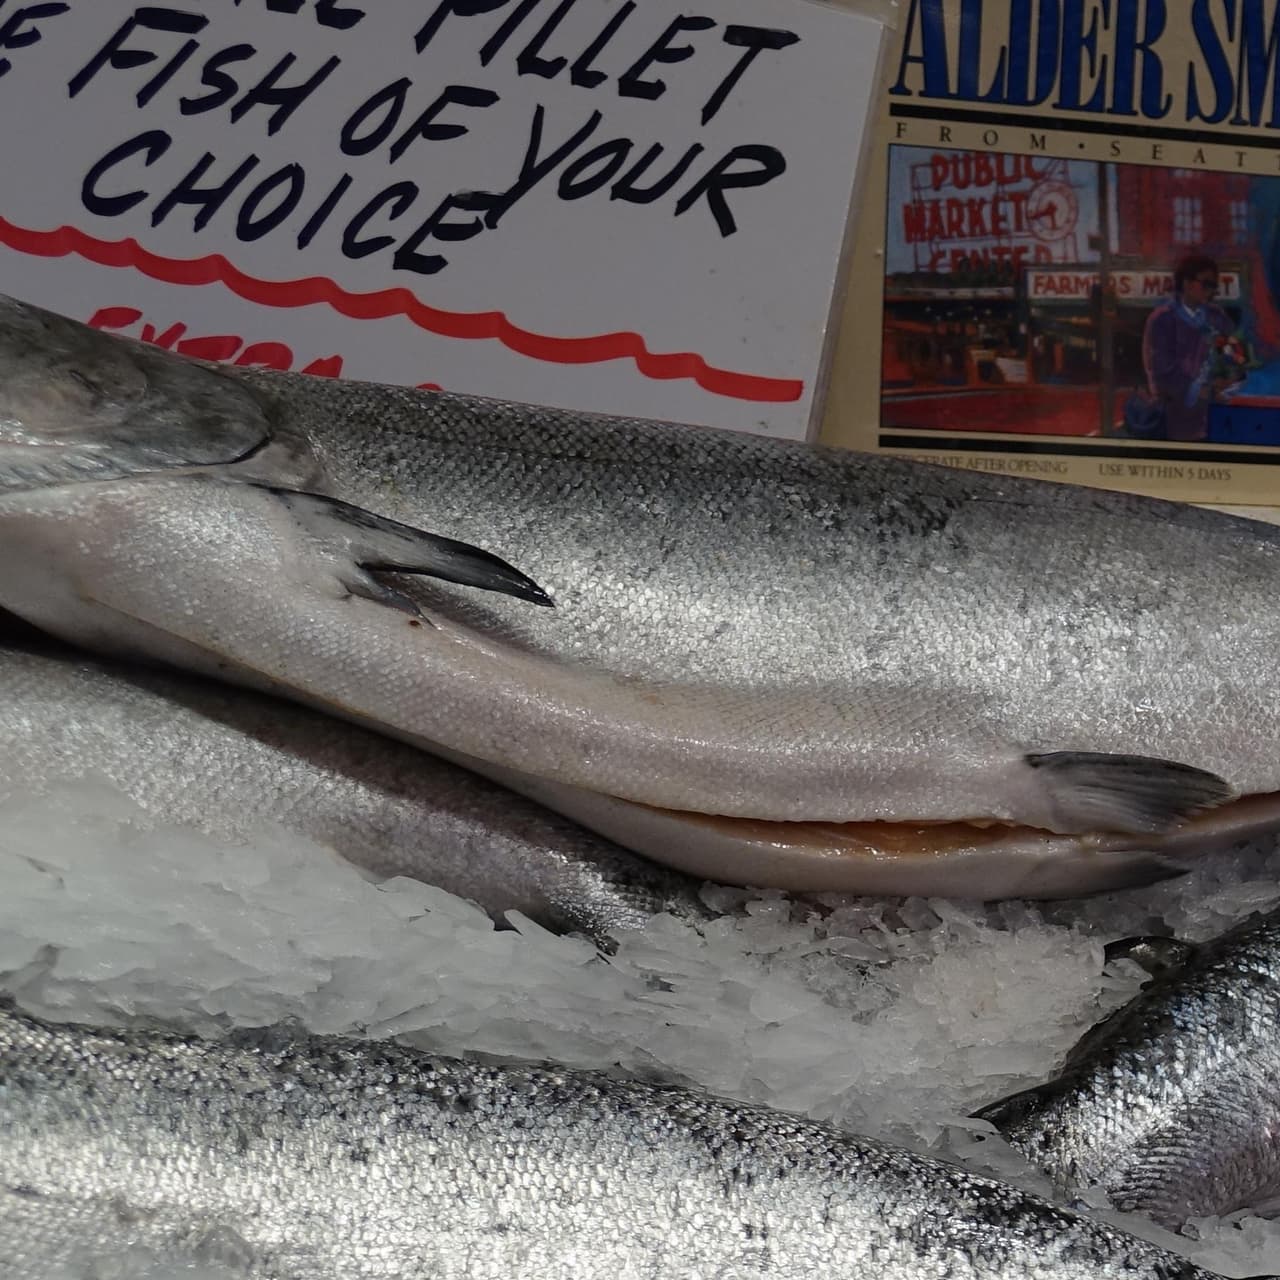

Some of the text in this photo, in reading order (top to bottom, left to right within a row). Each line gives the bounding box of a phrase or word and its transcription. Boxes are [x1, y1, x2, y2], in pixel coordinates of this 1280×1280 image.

[888, 0, 1173, 119] ALDER
[67, 7, 342, 137] FISH
[340, 77, 501, 164] OF
[484, 104, 786, 238] YOUR
[896, 121, 1047, 151] FROM
[930, 150, 1044, 191] PUBLIC
[81, 129, 489, 275] CHOICE
[902, 191, 1030, 244] MARKET
[1098, 463, 1125, 477] USE
[1126, 464, 1185, 480] WITHIN
[1197, 467, 1232, 482] DAYS
